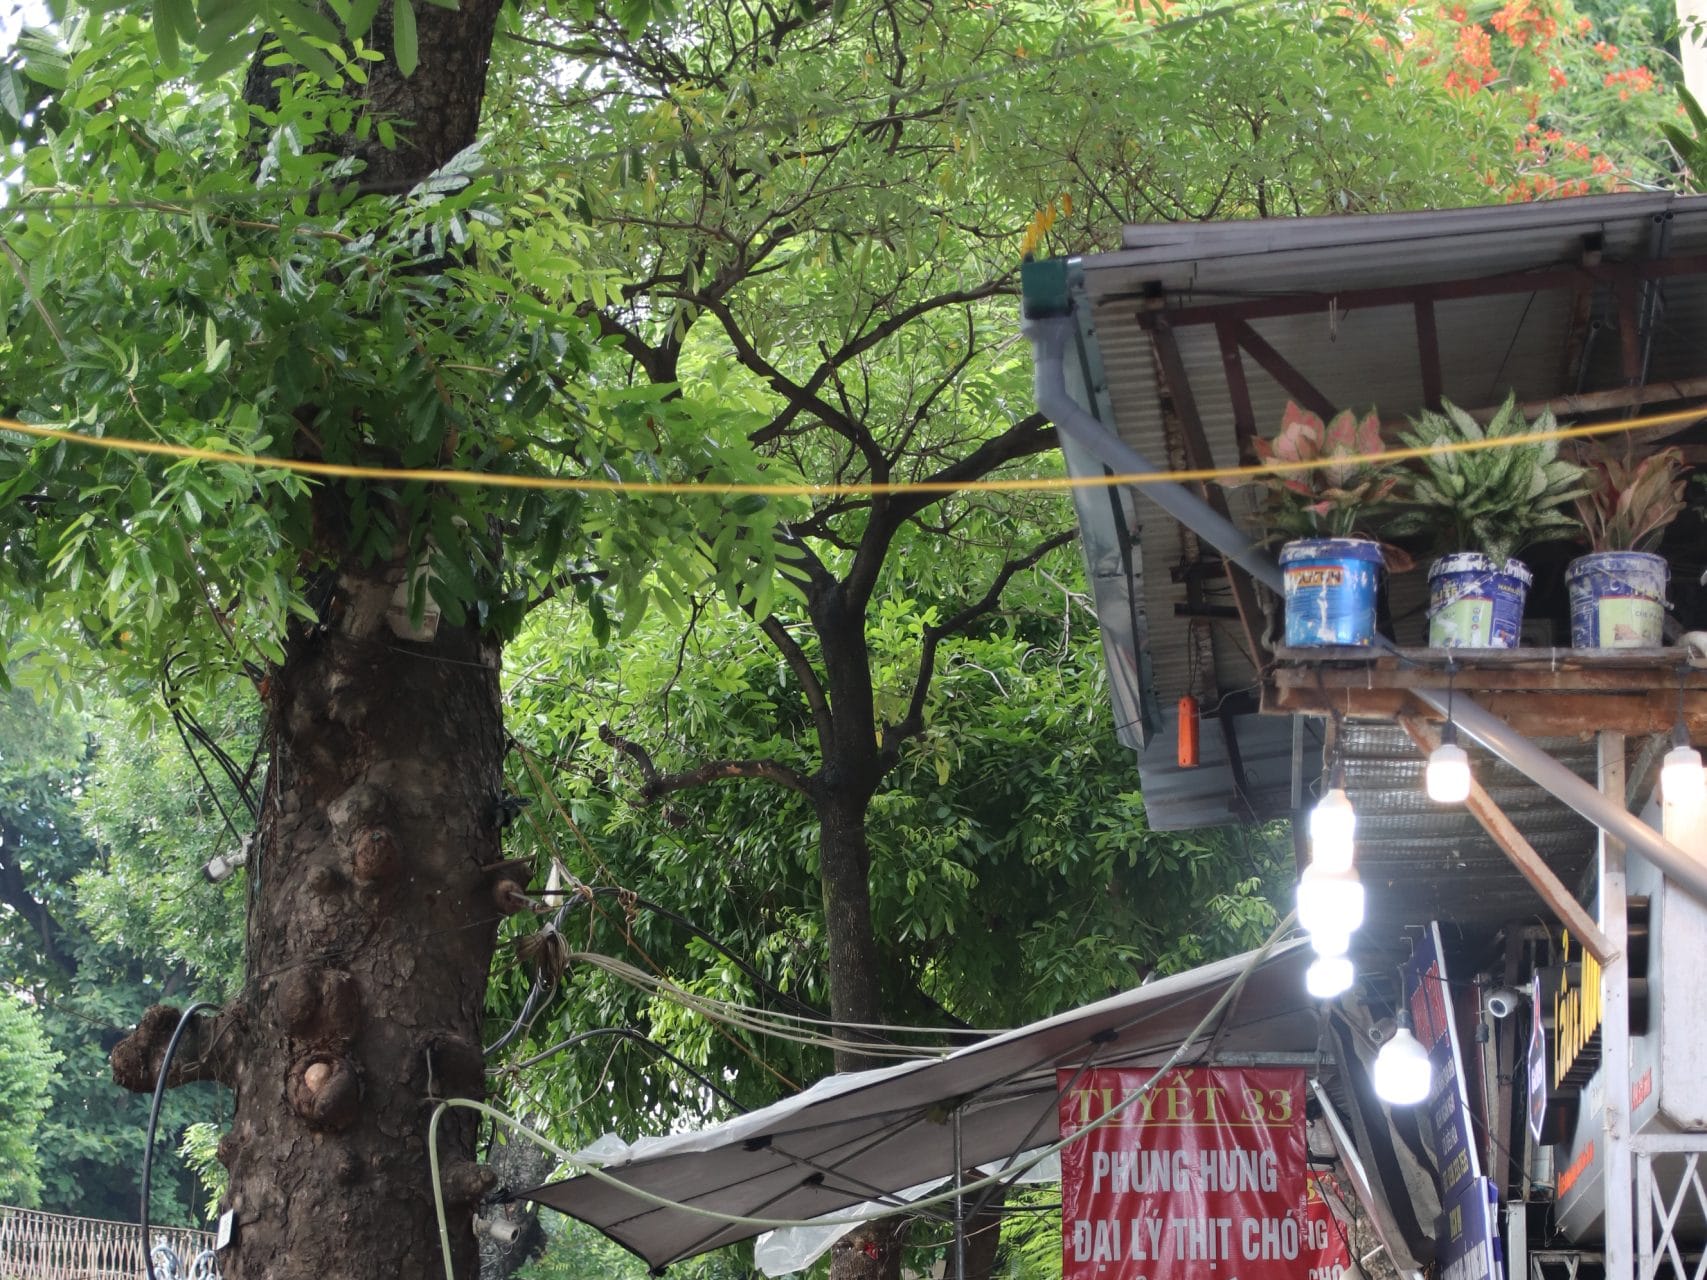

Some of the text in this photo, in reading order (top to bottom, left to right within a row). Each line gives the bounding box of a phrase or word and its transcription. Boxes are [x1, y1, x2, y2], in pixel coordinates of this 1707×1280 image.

[1069, 1069, 1293, 1122] TUYẾT 33
[1092, 1140, 1191, 1194] PHÙNG
[1073, 1218, 1121, 1272] ĐẠI
[1131, 1209, 1163, 1261] LÝ
[1173, 1217, 1233, 1270] THỊT
[1242, 1209, 1299, 1261] CHÓ
